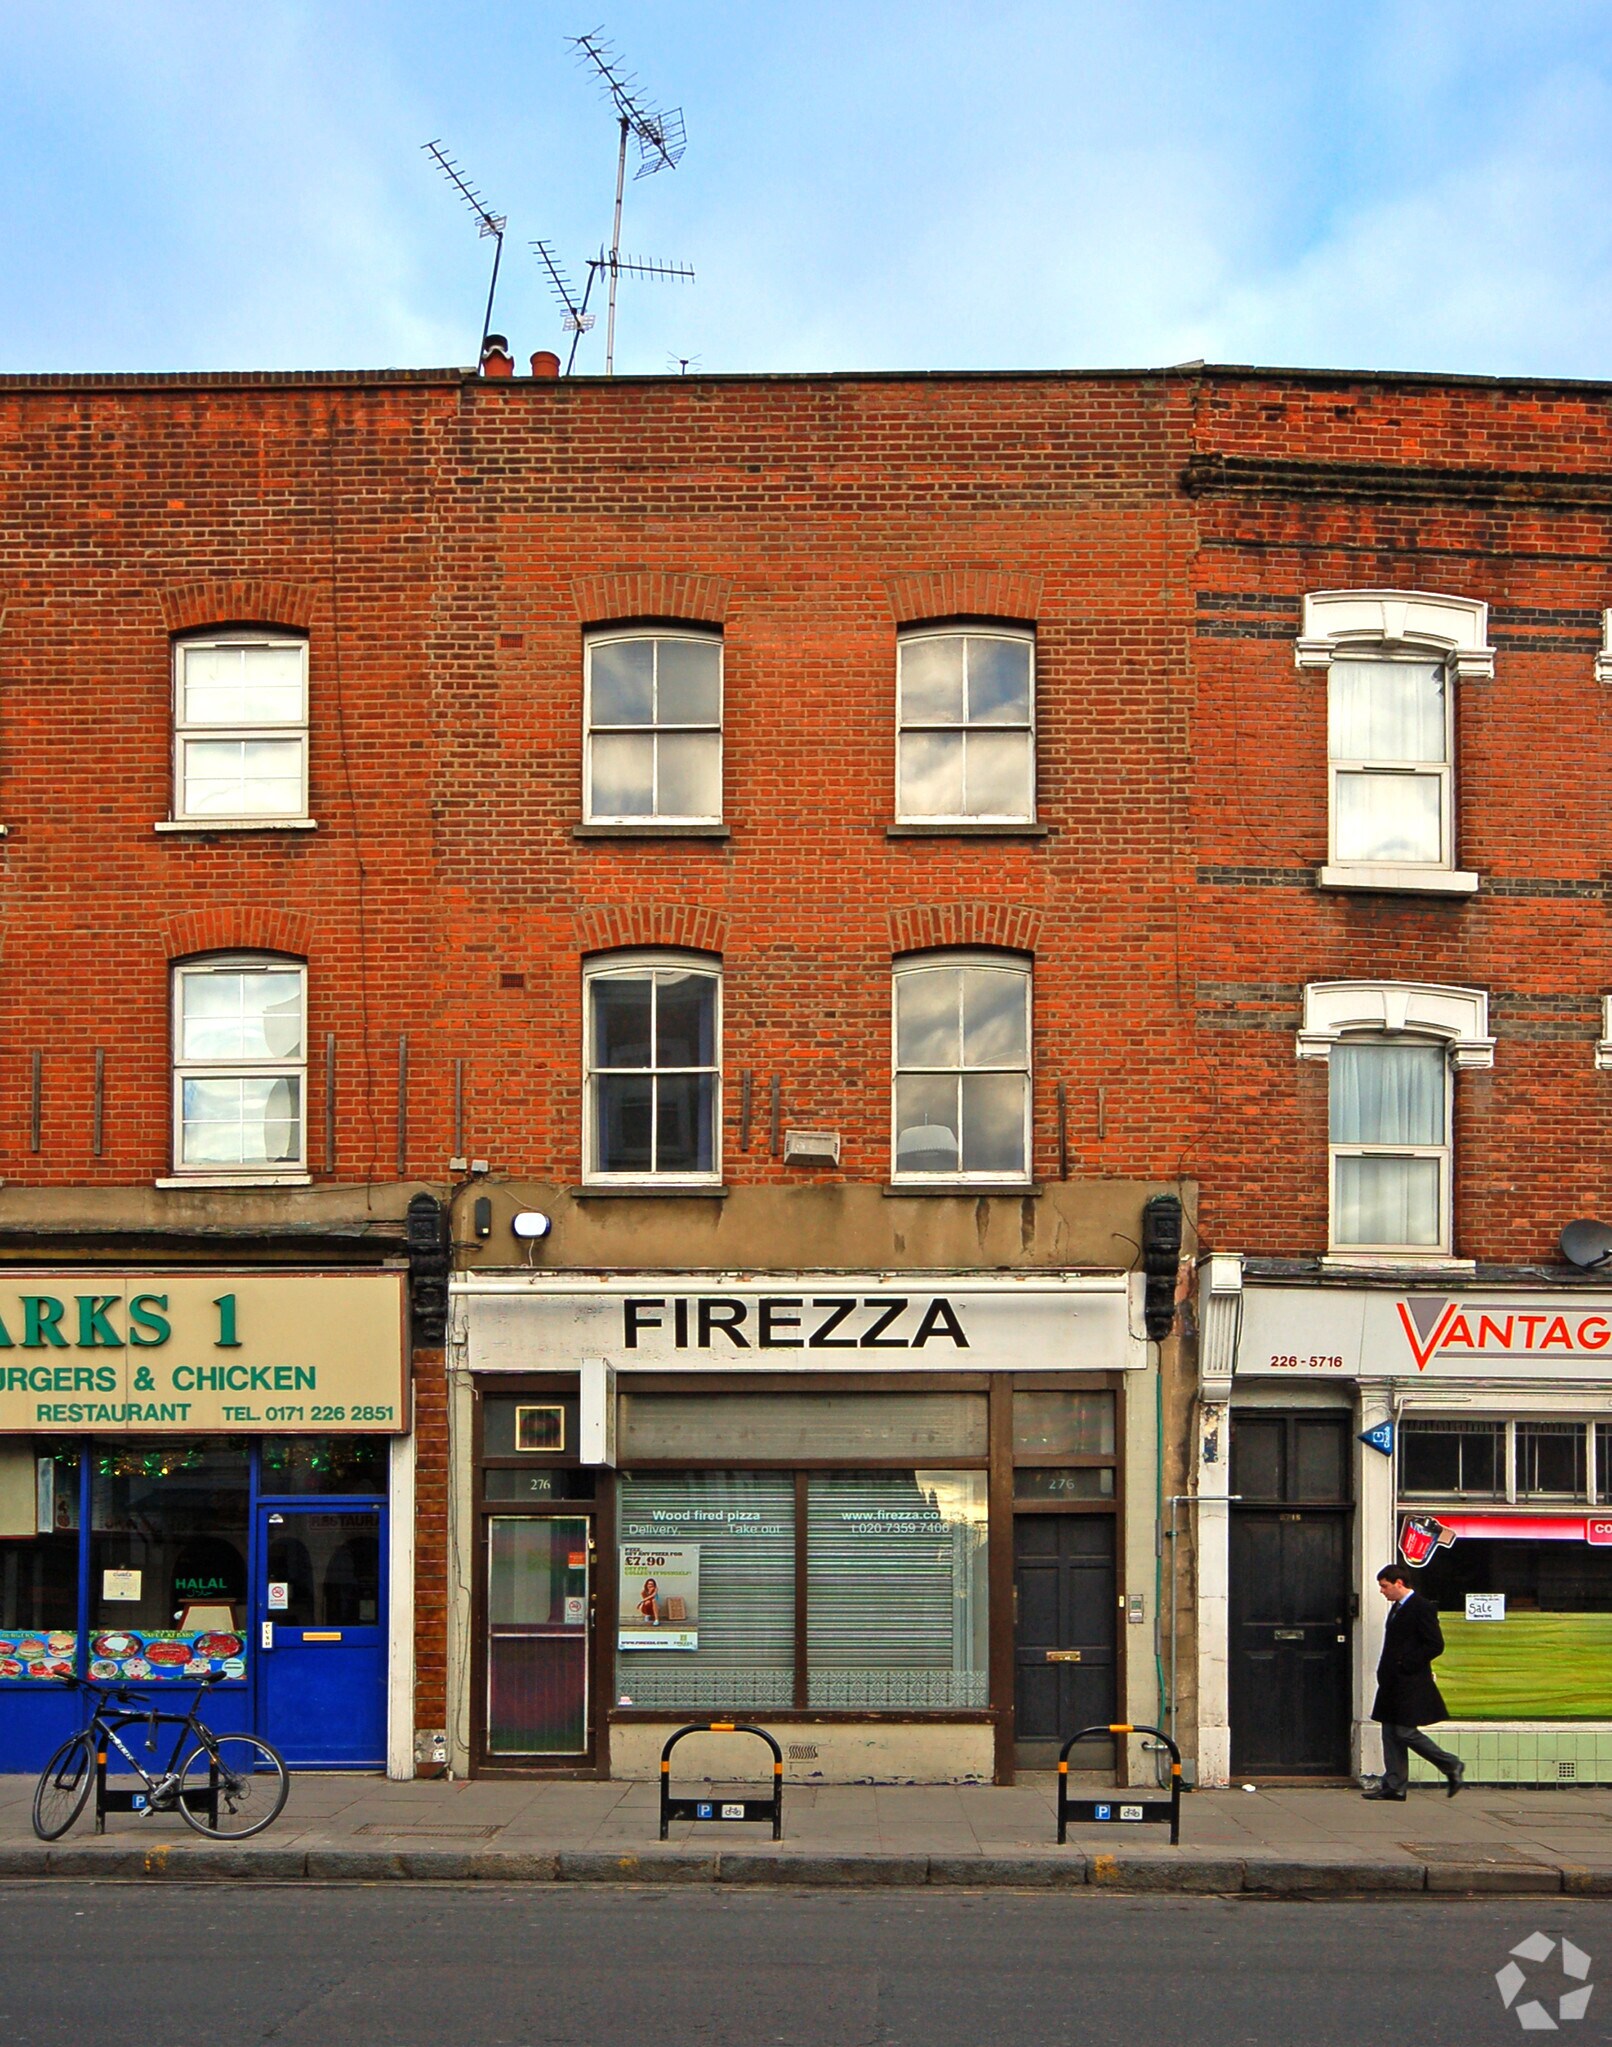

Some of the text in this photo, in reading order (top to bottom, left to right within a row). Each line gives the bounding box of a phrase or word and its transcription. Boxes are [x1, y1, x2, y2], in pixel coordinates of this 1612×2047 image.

[0, 1293, 242, 1347] RKS 1
[623, 1297, 970, 1349] FIREZZA
[1396, 1302, 1612, 1372] VANTAG
[133, 1366, 155, 1392] &
[172, 1365, 316, 1391] CHICKEN
[36, 1403, 192, 1422] RESTAURANT
[222, 1406, 394, 1421] TEL. 0171 226 2851
[1383, 1426, 1391, 1448] Chubb
[530, 1479, 551, 1490] 276
[1048, 1478, 1075, 1490] 276
[652, 1510, 761, 1523] Wood fired pizza
[728, 1524, 758, 1534] Take
[886, 1522, 916, 1534] 7359
[624, 1556, 666, 1567] £7.90
[175, 1577, 228, 1590] HALAL
[1468, 1602, 1493, 1615] Sale
[135, 1796, 146, 1807] P
[701, 1804, 710, 1816] P
[1099, 1805, 1108, 1818] P
